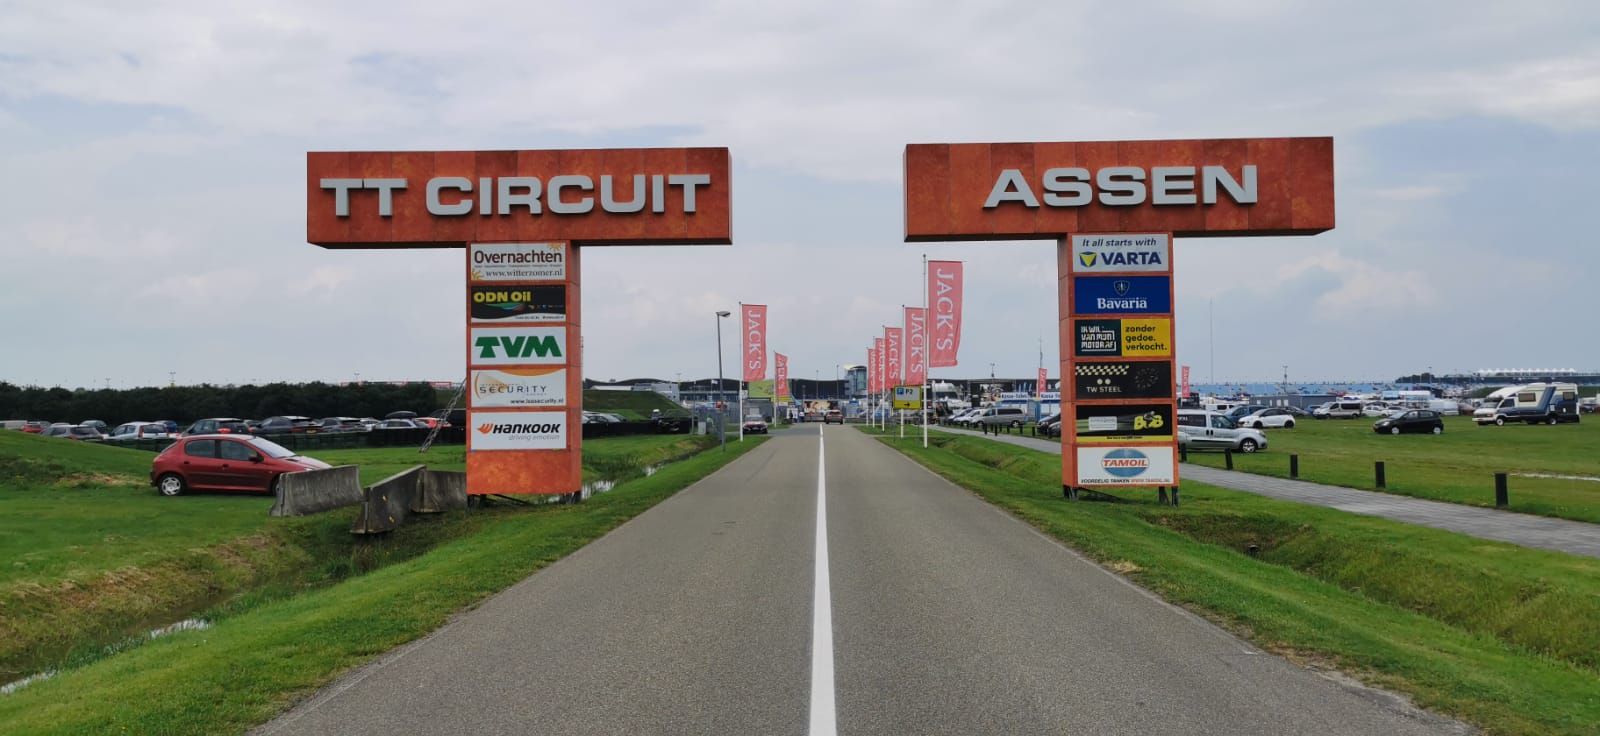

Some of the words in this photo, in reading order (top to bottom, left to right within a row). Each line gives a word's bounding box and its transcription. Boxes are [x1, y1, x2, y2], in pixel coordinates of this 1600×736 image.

[982, 164, 1258, 208] ASSEN
[319, 177, 408, 217] TT
[425, 173, 711, 216] CIRCUIT
[1082, 239, 1090, 247] It
[1092, 238, 1103, 247] all
[1105, 239, 1133, 247] starts
[1135, 237, 1157, 247] with
[474, 250, 563, 264] Overnachten
[1101, 251, 1162, 265] VARTA
[485, 268, 563, 277] www.witterzomer.nl
[473, 291, 509, 303] ODN
[510, 291, 532, 302] Oil
[936, 268, 954, 351] JACK'S
[1097, 297, 1148, 310] Bavaria
[1125, 325, 1156, 333] zonder
[748, 310, 762, 370] JACK'S
[1125, 334, 1156, 343] gedoe.
[475, 335, 562, 358] TVM
[1126, 343, 1168, 351] verkocht.
[480, 385, 547, 394] SECURITY
[1103, 459, 1147, 467] TAMOIL
